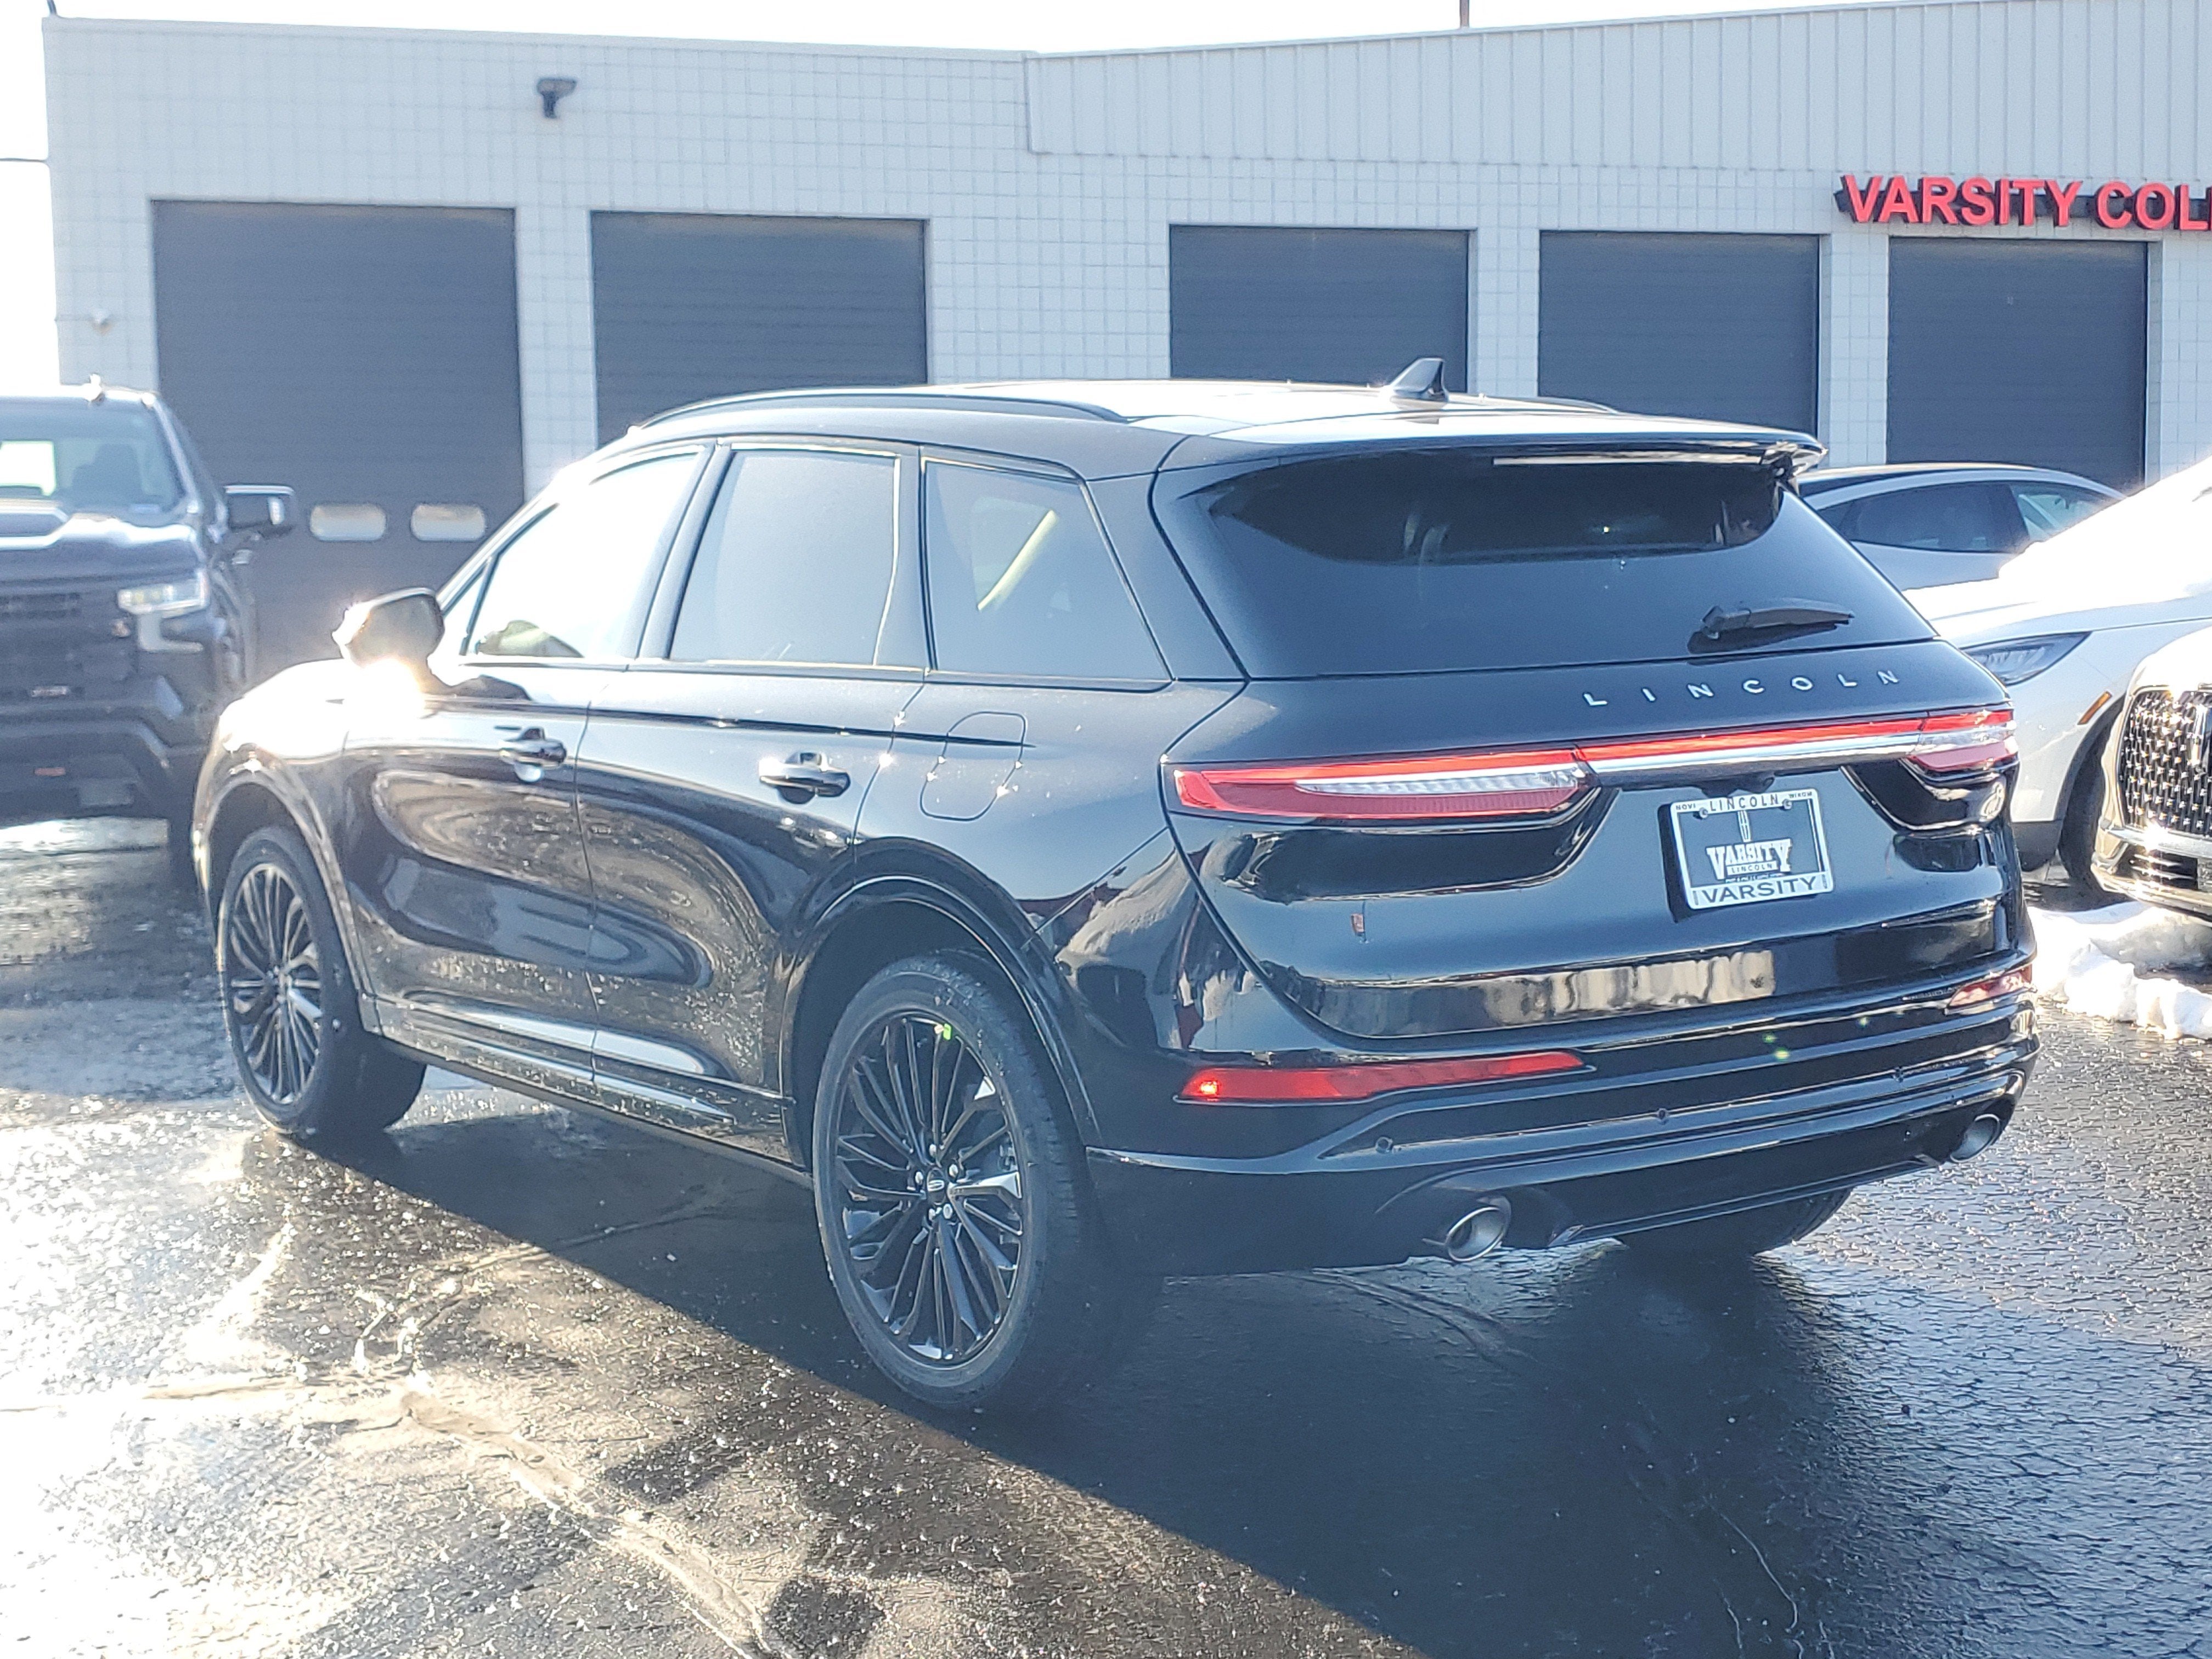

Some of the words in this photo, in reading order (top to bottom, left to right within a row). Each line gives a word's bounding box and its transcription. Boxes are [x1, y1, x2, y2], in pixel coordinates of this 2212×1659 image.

[1841, 174, 2083, 227] VARSITY
[2096, 180, 2212, 230] COL
[1584, 669, 1899, 706] LINCOLN
[1709, 793, 1779, 812] LINCOLN
[1706, 838, 1791, 880] VARSITY
[1731, 862, 1773, 874] LINCOLN
[1702, 876, 1816, 904] VARSITY
